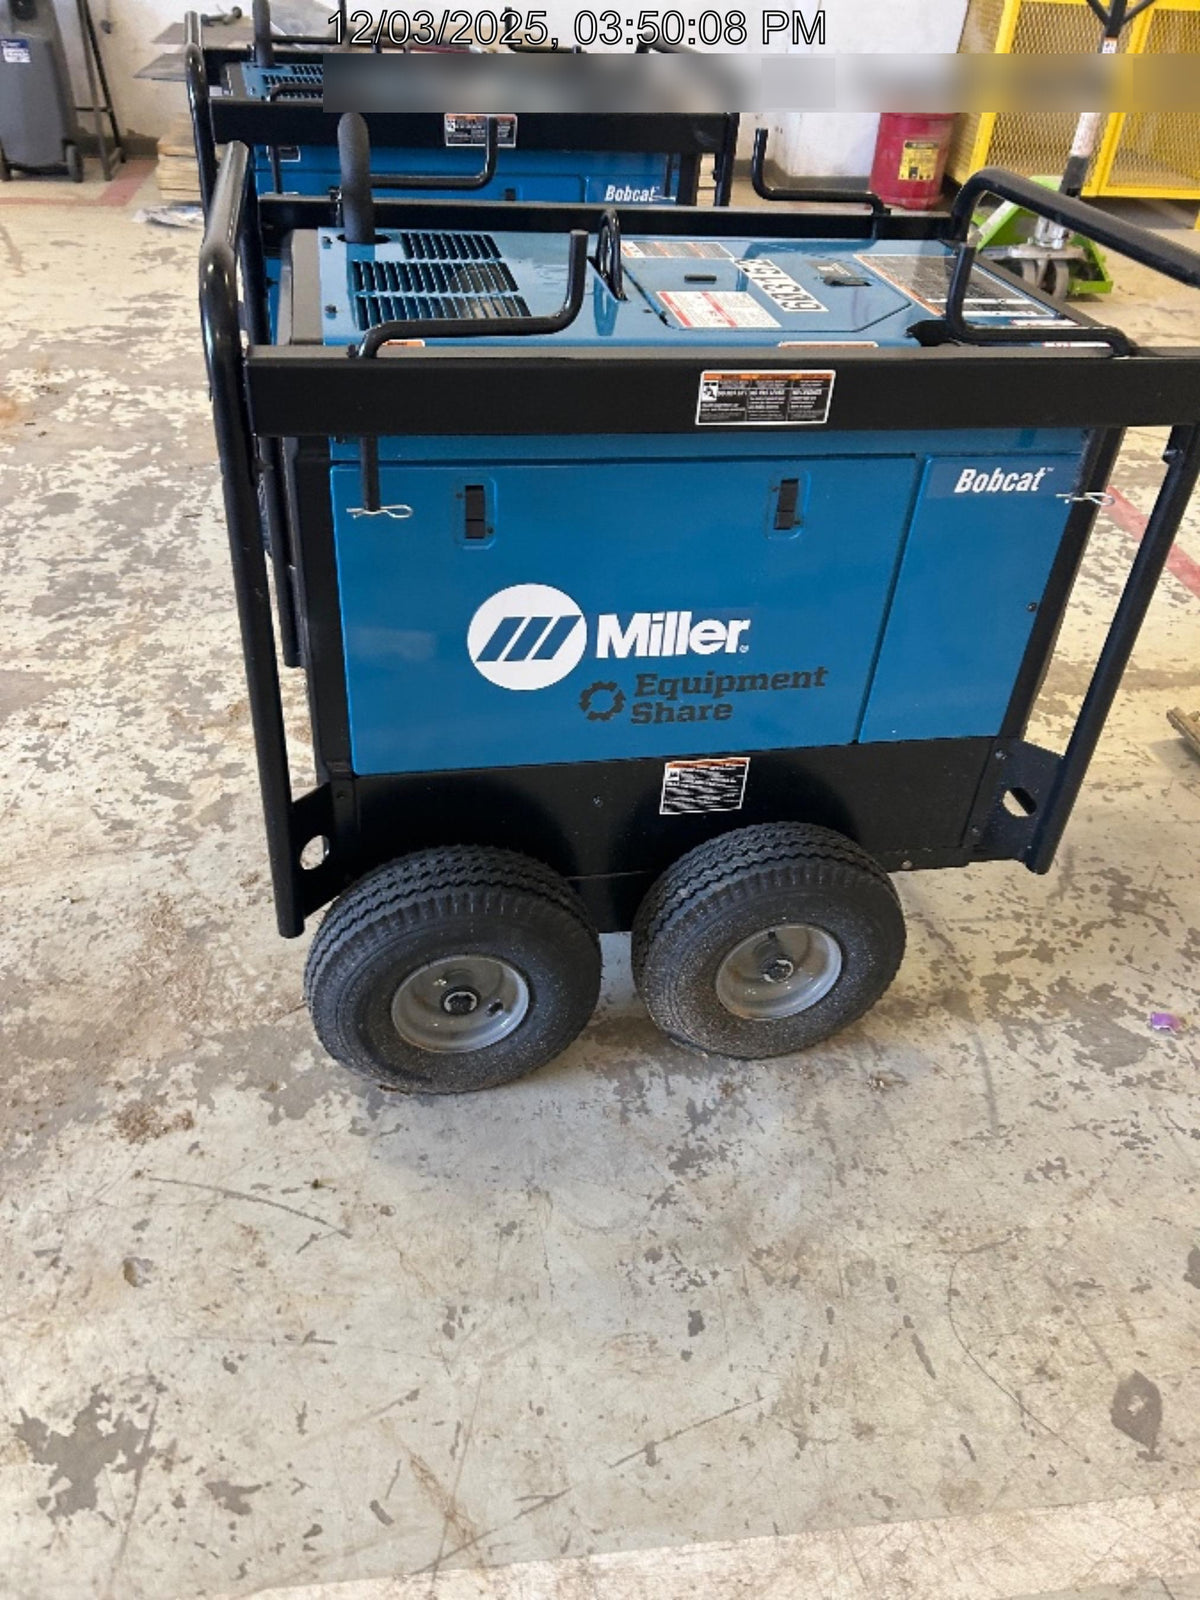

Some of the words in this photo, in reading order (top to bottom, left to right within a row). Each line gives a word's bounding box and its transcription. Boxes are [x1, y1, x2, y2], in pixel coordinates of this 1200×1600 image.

[604, 184, 656, 202] Bobcat
[596, 611, 751, 659] Miller
[635, 666, 828, 698] Equipment
[631, 702, 733, 724] Share
